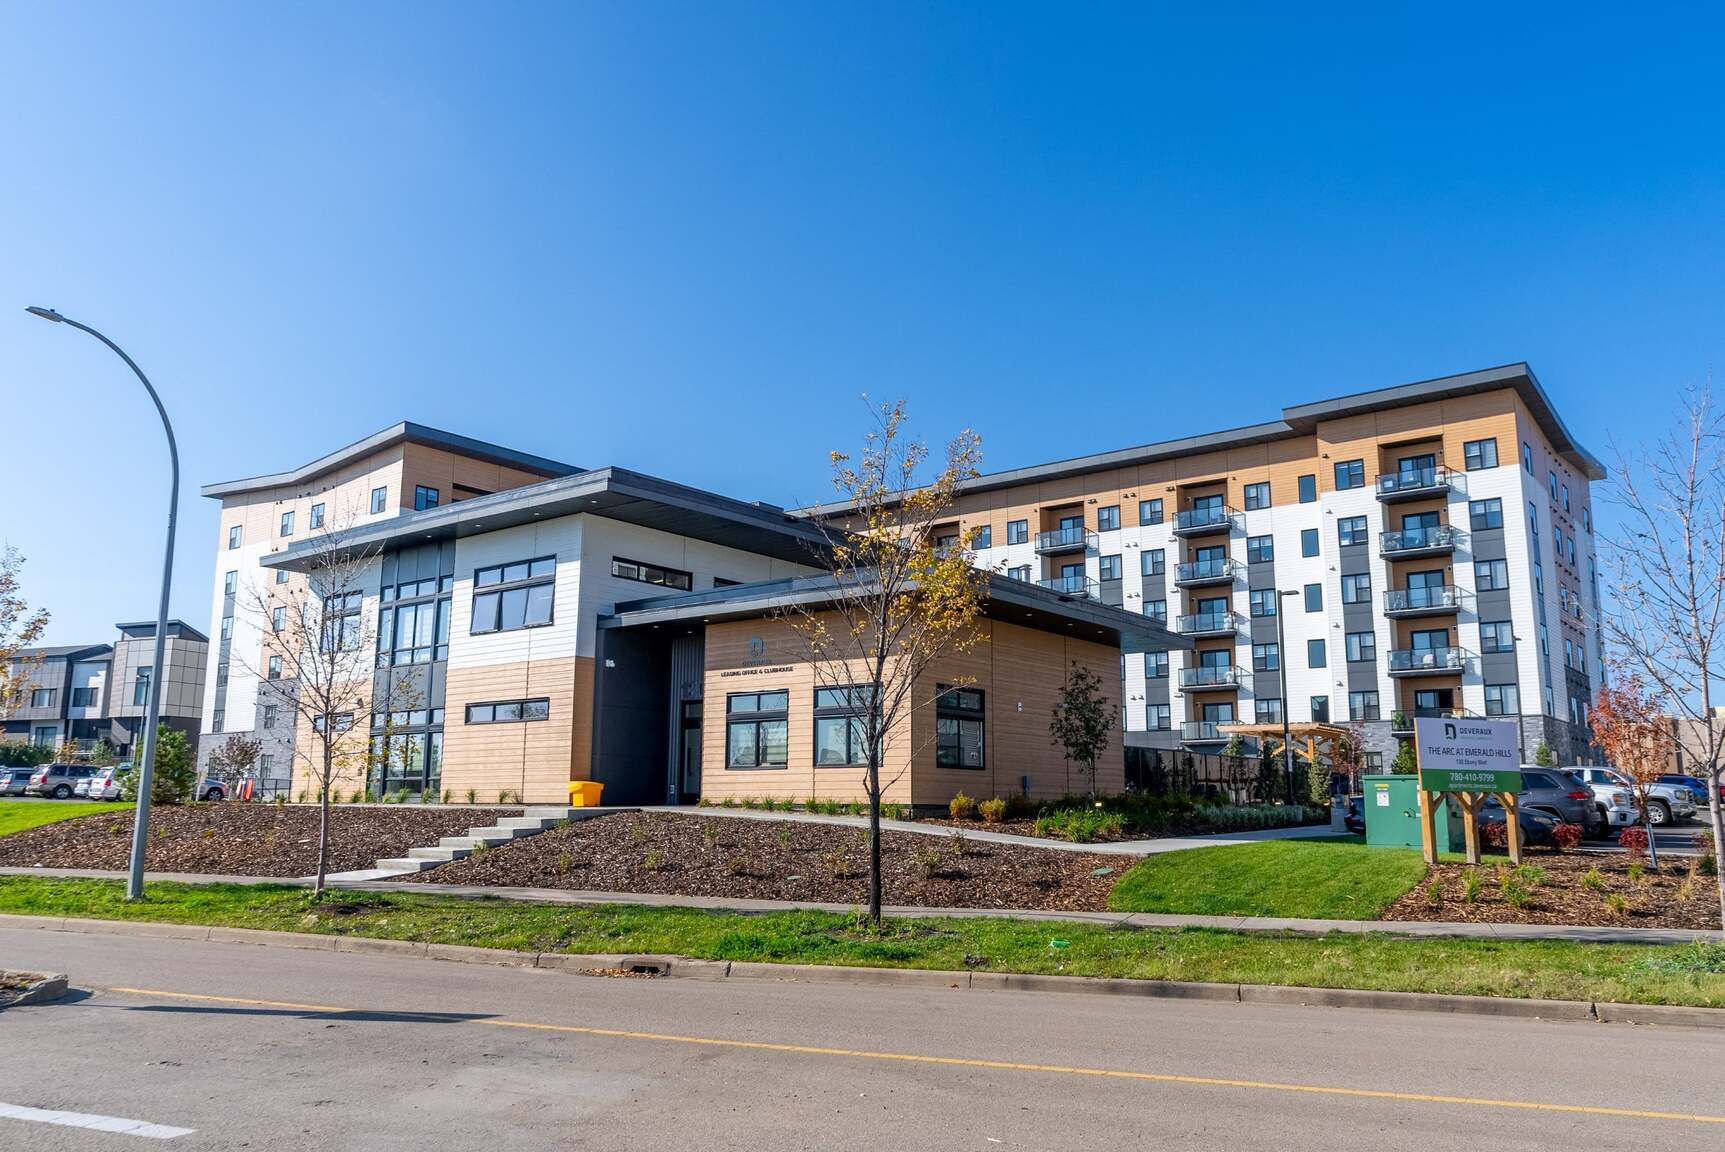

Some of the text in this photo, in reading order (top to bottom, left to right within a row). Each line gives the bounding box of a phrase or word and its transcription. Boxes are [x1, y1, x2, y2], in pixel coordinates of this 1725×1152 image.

[764, 666, 794, 674] CLUBHOUSE
[1460, 727, 1492, 736] DEVERAUX
[1427, 746, 1512, 758] THE ARC AT EMERALD HILLS
[1449, 772, 1495, 782] 780-410-9799
